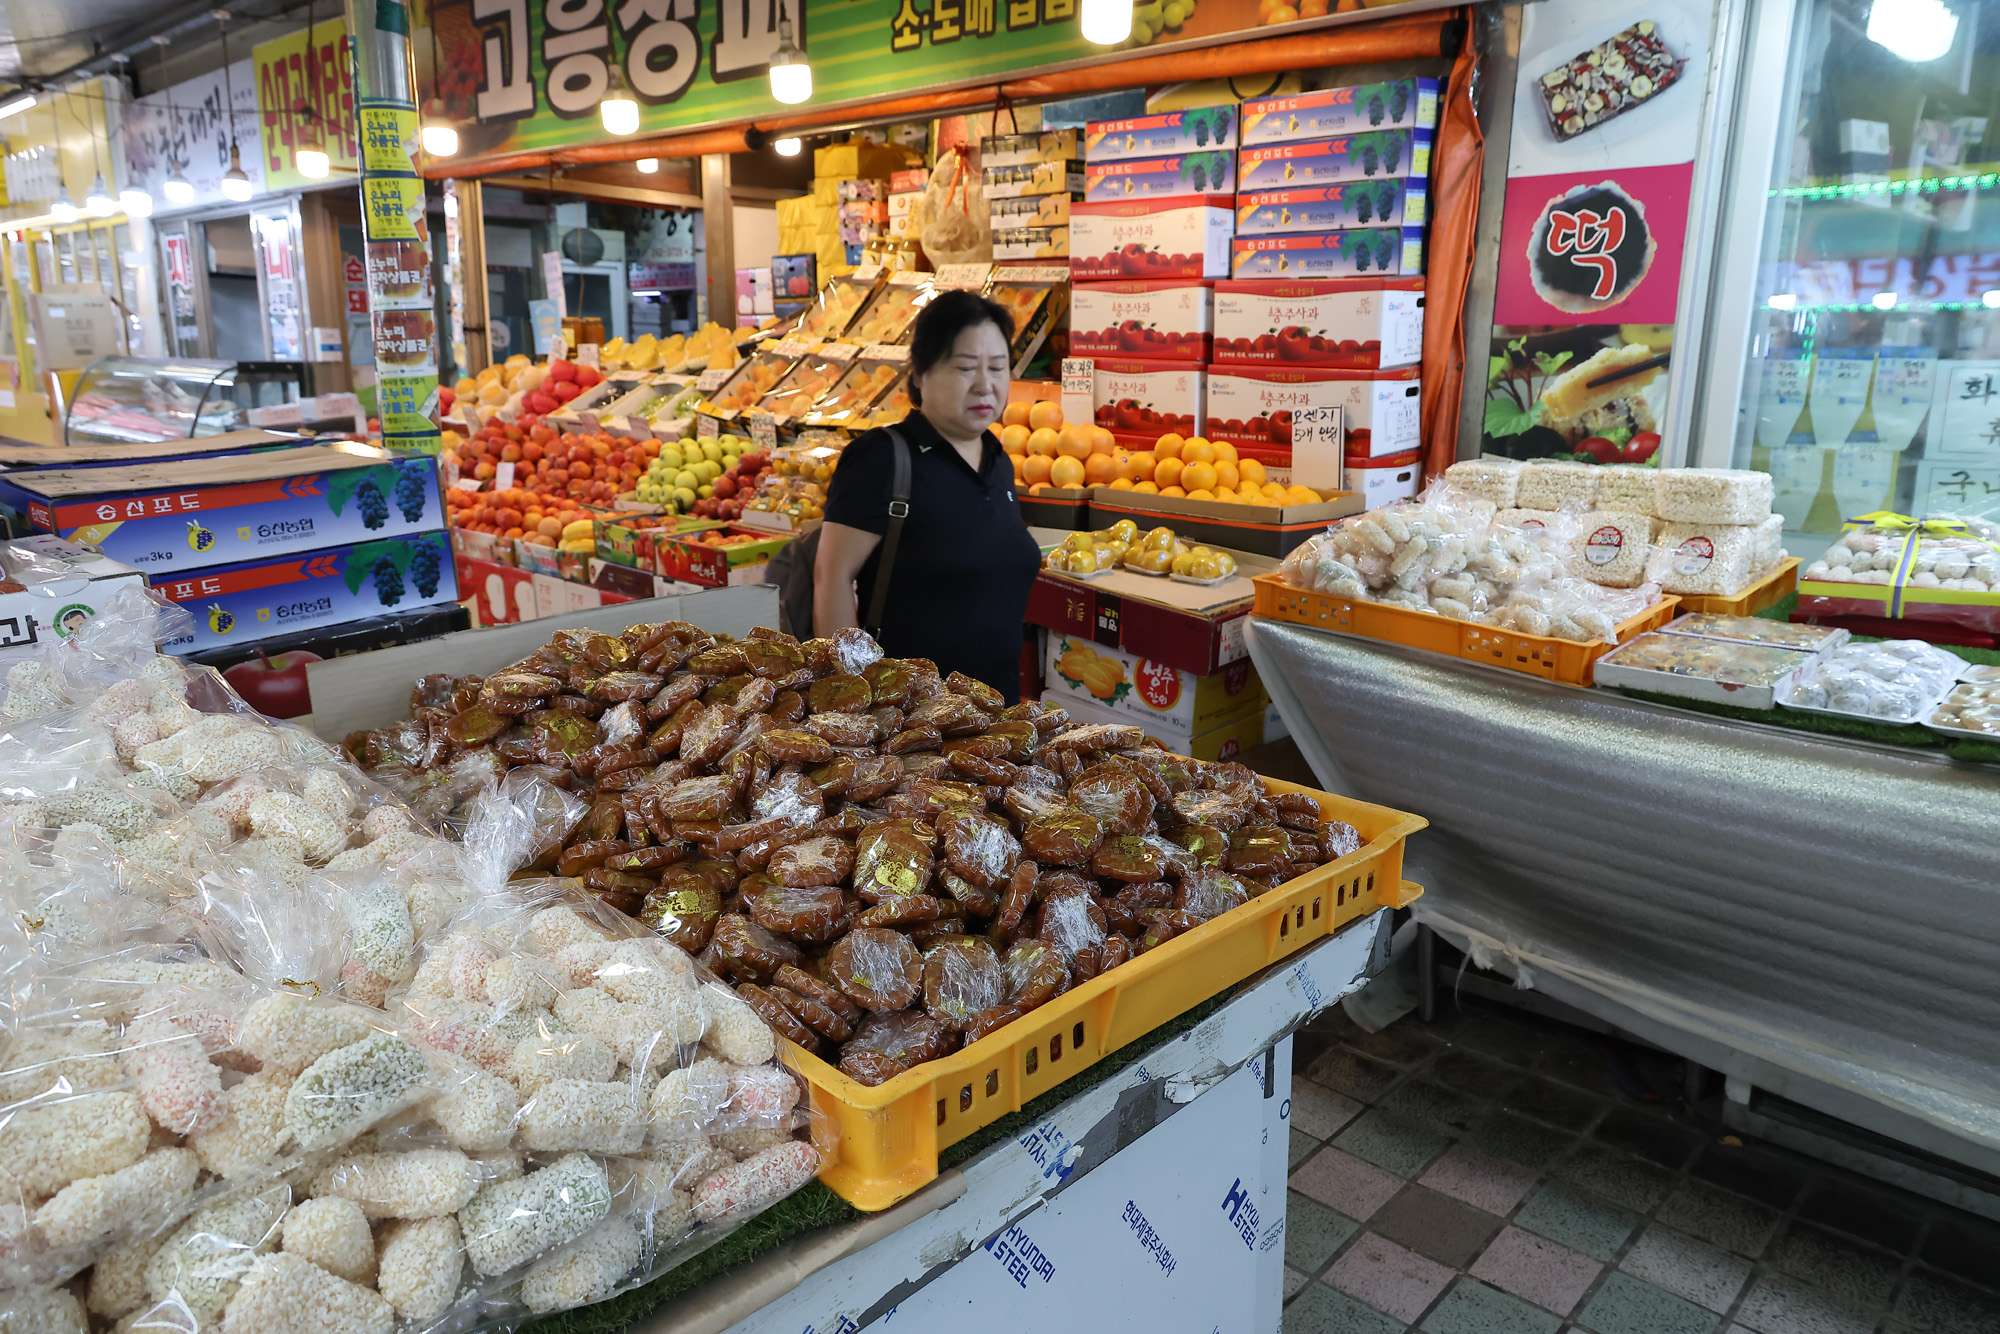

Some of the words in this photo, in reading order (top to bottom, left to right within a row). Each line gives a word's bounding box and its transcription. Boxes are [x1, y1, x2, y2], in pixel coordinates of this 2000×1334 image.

[367, 120, 399, 133] 온누리
[367, 131, 400, 148] 상품권
[370, 190, 402, 202] 온누리
[372, 201, 404, 217] 상품권
[1547, 206, 1627, 300] 떡
[376, 326, 406, 340] 온누리
[381, 387, 414, 401] 온누리
[383, 401, 416, 414] 상품권
[1293, 409, 1334, 425] 오렌지
[1293, 427, 1313, 443] 5개
[96, 493, 200, 521] 송산포도
[257, 517, 314, 538] 송산농협
[151, 550, 173, 561] 3kg
[276, 597, 332, 618] 송산농협
[1143, 660, 1175, 695] 성주
[1146, 687, 1168, 705] 참외
[1120, 1200, 1179, 1278] 현대제철주식회사
[1233, 1216, 1255, 1251] STEEL
[1006, 1224, 1056, 1283] HYUNDAI
[993, 1240, 1035, 1289] STEEL
